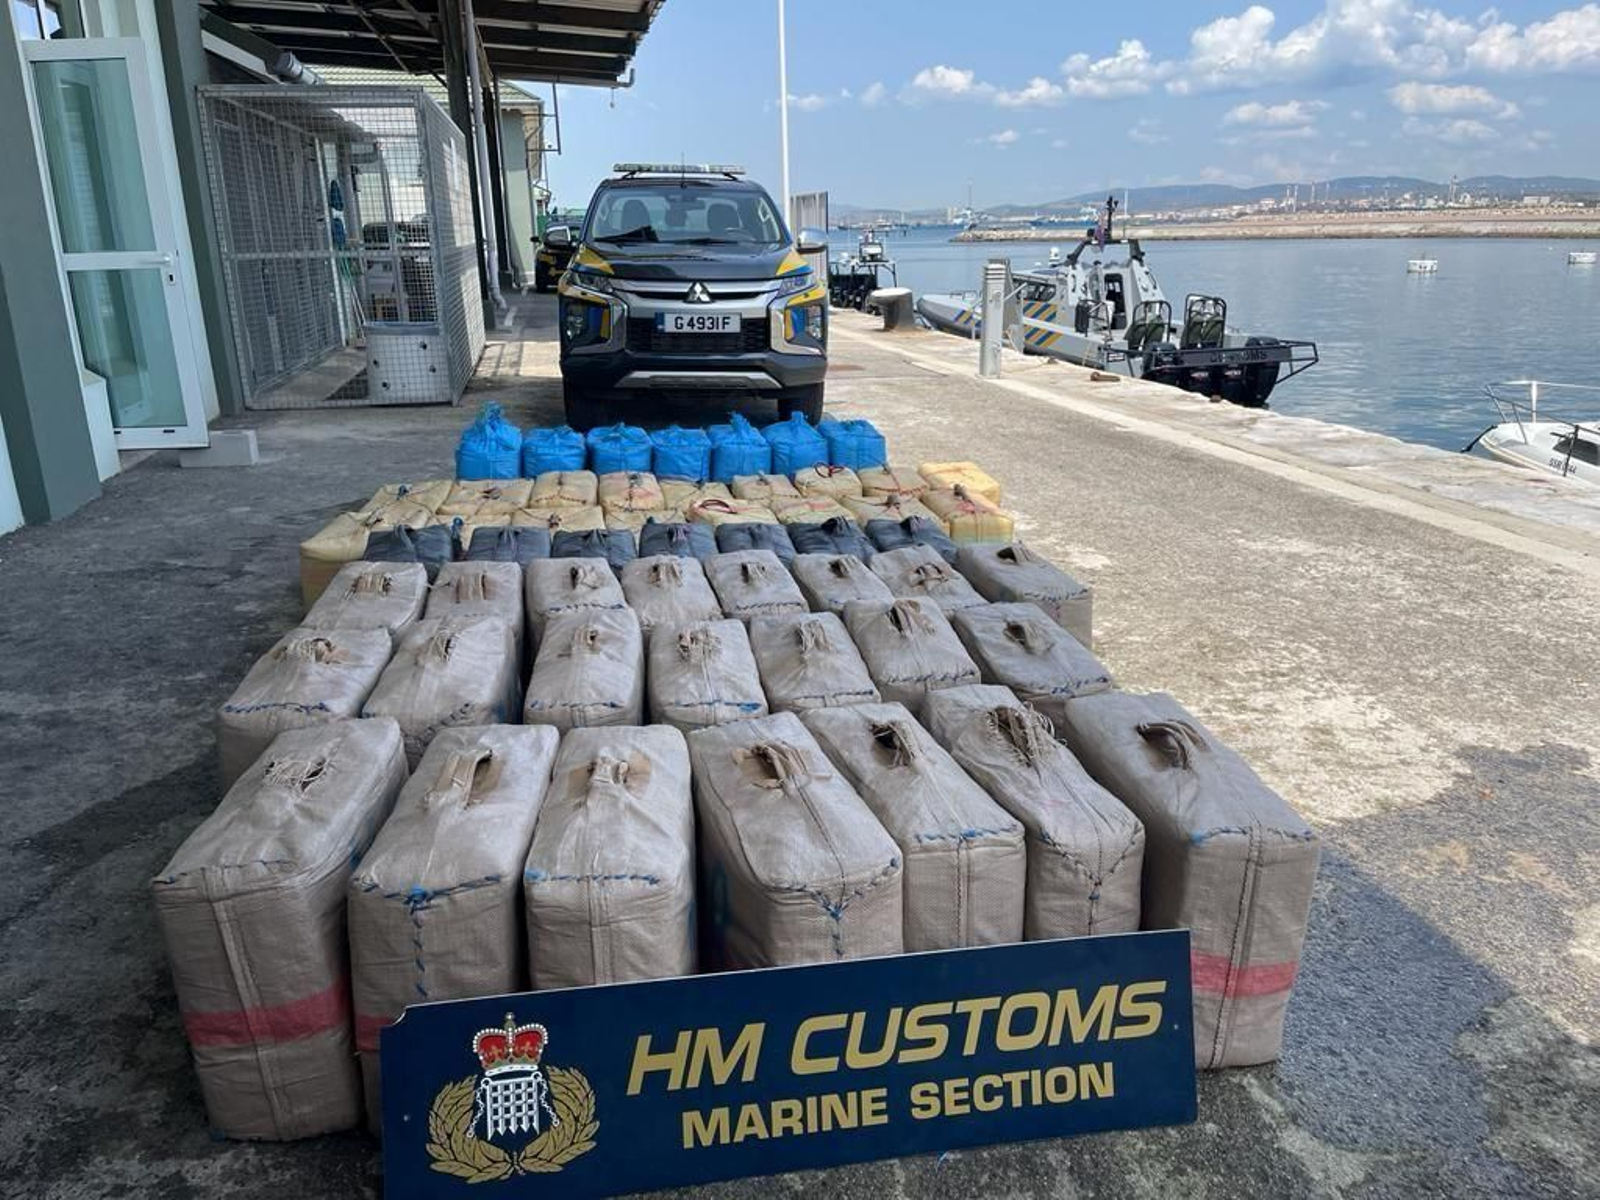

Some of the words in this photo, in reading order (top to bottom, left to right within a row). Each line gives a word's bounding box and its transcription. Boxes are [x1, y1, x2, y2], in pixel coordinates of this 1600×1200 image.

[627, 1023, 764, 1097] HM
[791, 980, 1167, 1075] CUSTOMS
[682, 1087, 888, 1149] MARINE
[910, 1062, 1115, 1119] SECTION
